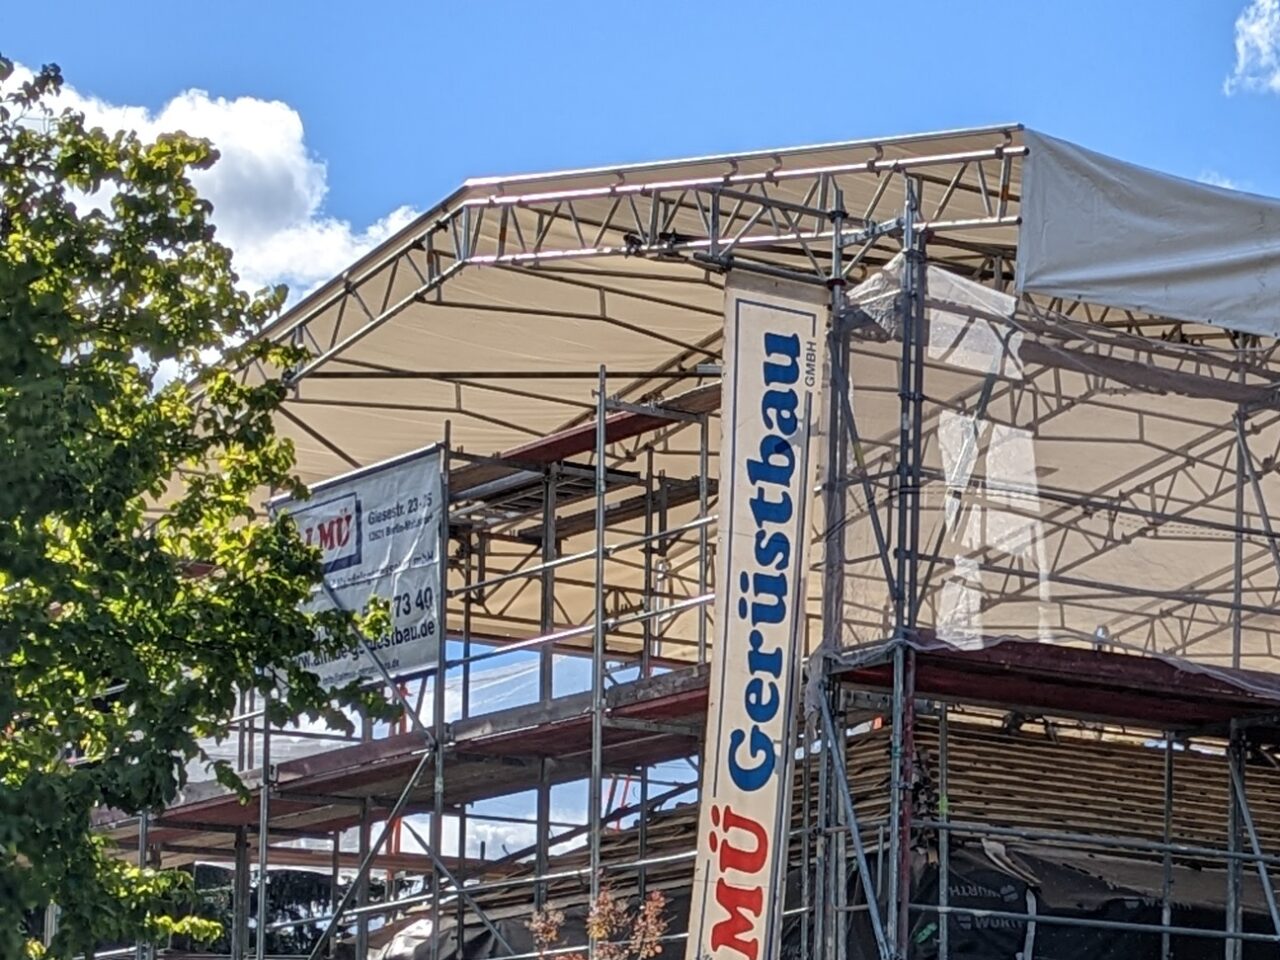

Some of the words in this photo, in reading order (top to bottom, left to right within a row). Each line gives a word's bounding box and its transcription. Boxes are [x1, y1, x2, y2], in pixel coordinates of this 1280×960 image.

[804, 341, 817, 389] GMBH
[305, 508, 352, 550] LMÜ
[728, 331, 801, 793] Gerüstbau
[394, 593, 412, 617] 73
[415, 587, 433, 610] 40
